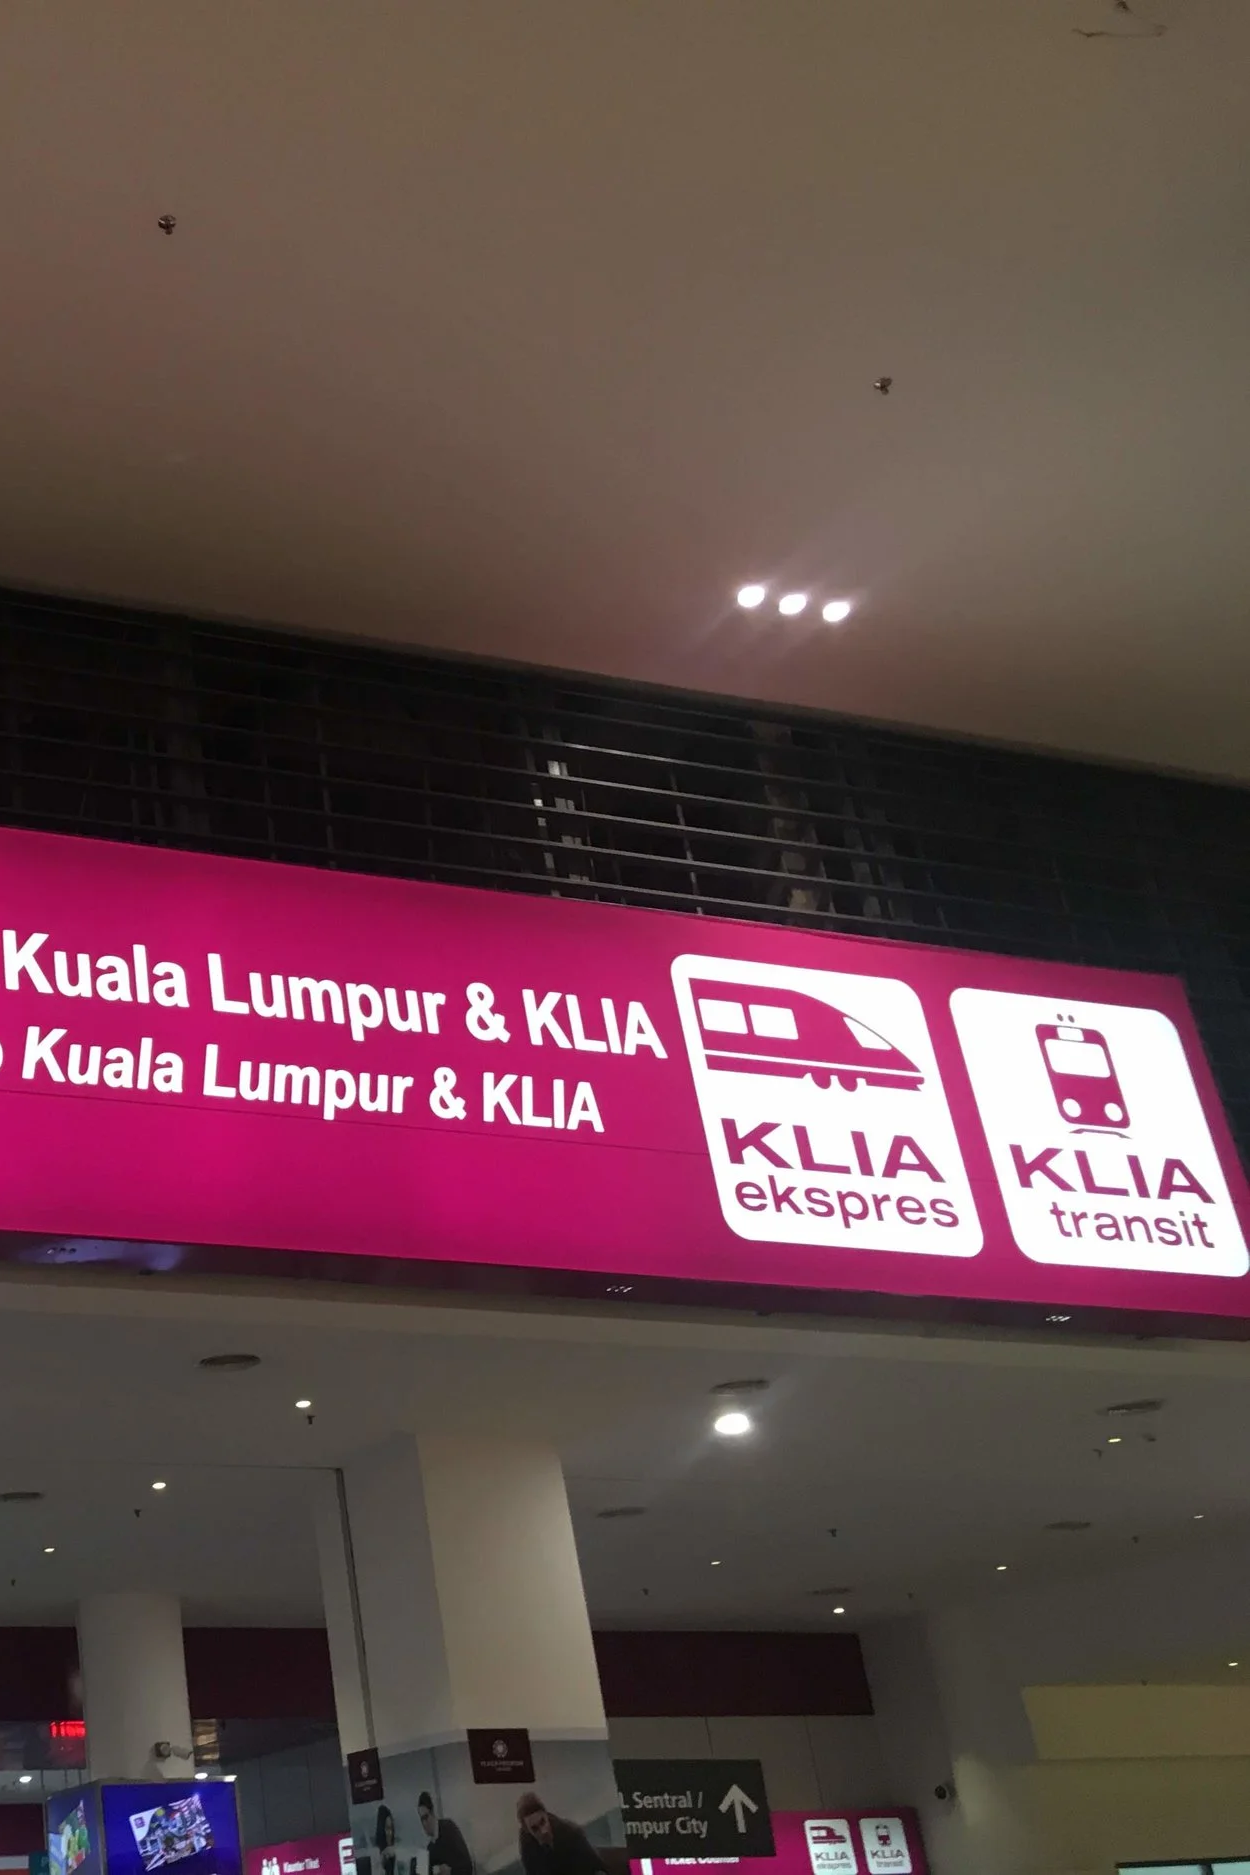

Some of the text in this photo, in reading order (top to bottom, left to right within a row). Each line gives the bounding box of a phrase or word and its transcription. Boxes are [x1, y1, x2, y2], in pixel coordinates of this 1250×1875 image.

[2, 929, 190, 1008] Kuala
[207, 952, 447, 1042] Lumpur
[465, 982, 511, 1043] &
[521, 988, 669, 1059] KLIA
[21, 1025, 184, 1094] Kuala
[202, 1043, 414, 1121] Lumpur
[429, 1066, 467, 1121] &
[482, 1071, 605, 1133] KLIA
[721, 1118, 946, 1183] KLIA
[1009, 1143, 1216, 1204] KLIA
[735, 1175, 960, 1230] ekspres
[1050, 1202, 1215, 1248] transit
[618, 1791, 629, 1809] L
[632, 1790, 693, 1810] Sentral
[626, 1816, 708, 1840] mpur City
[814, 1851, 850, 1861] KLIA
[870, 1849, 905, 1859] KLIA
